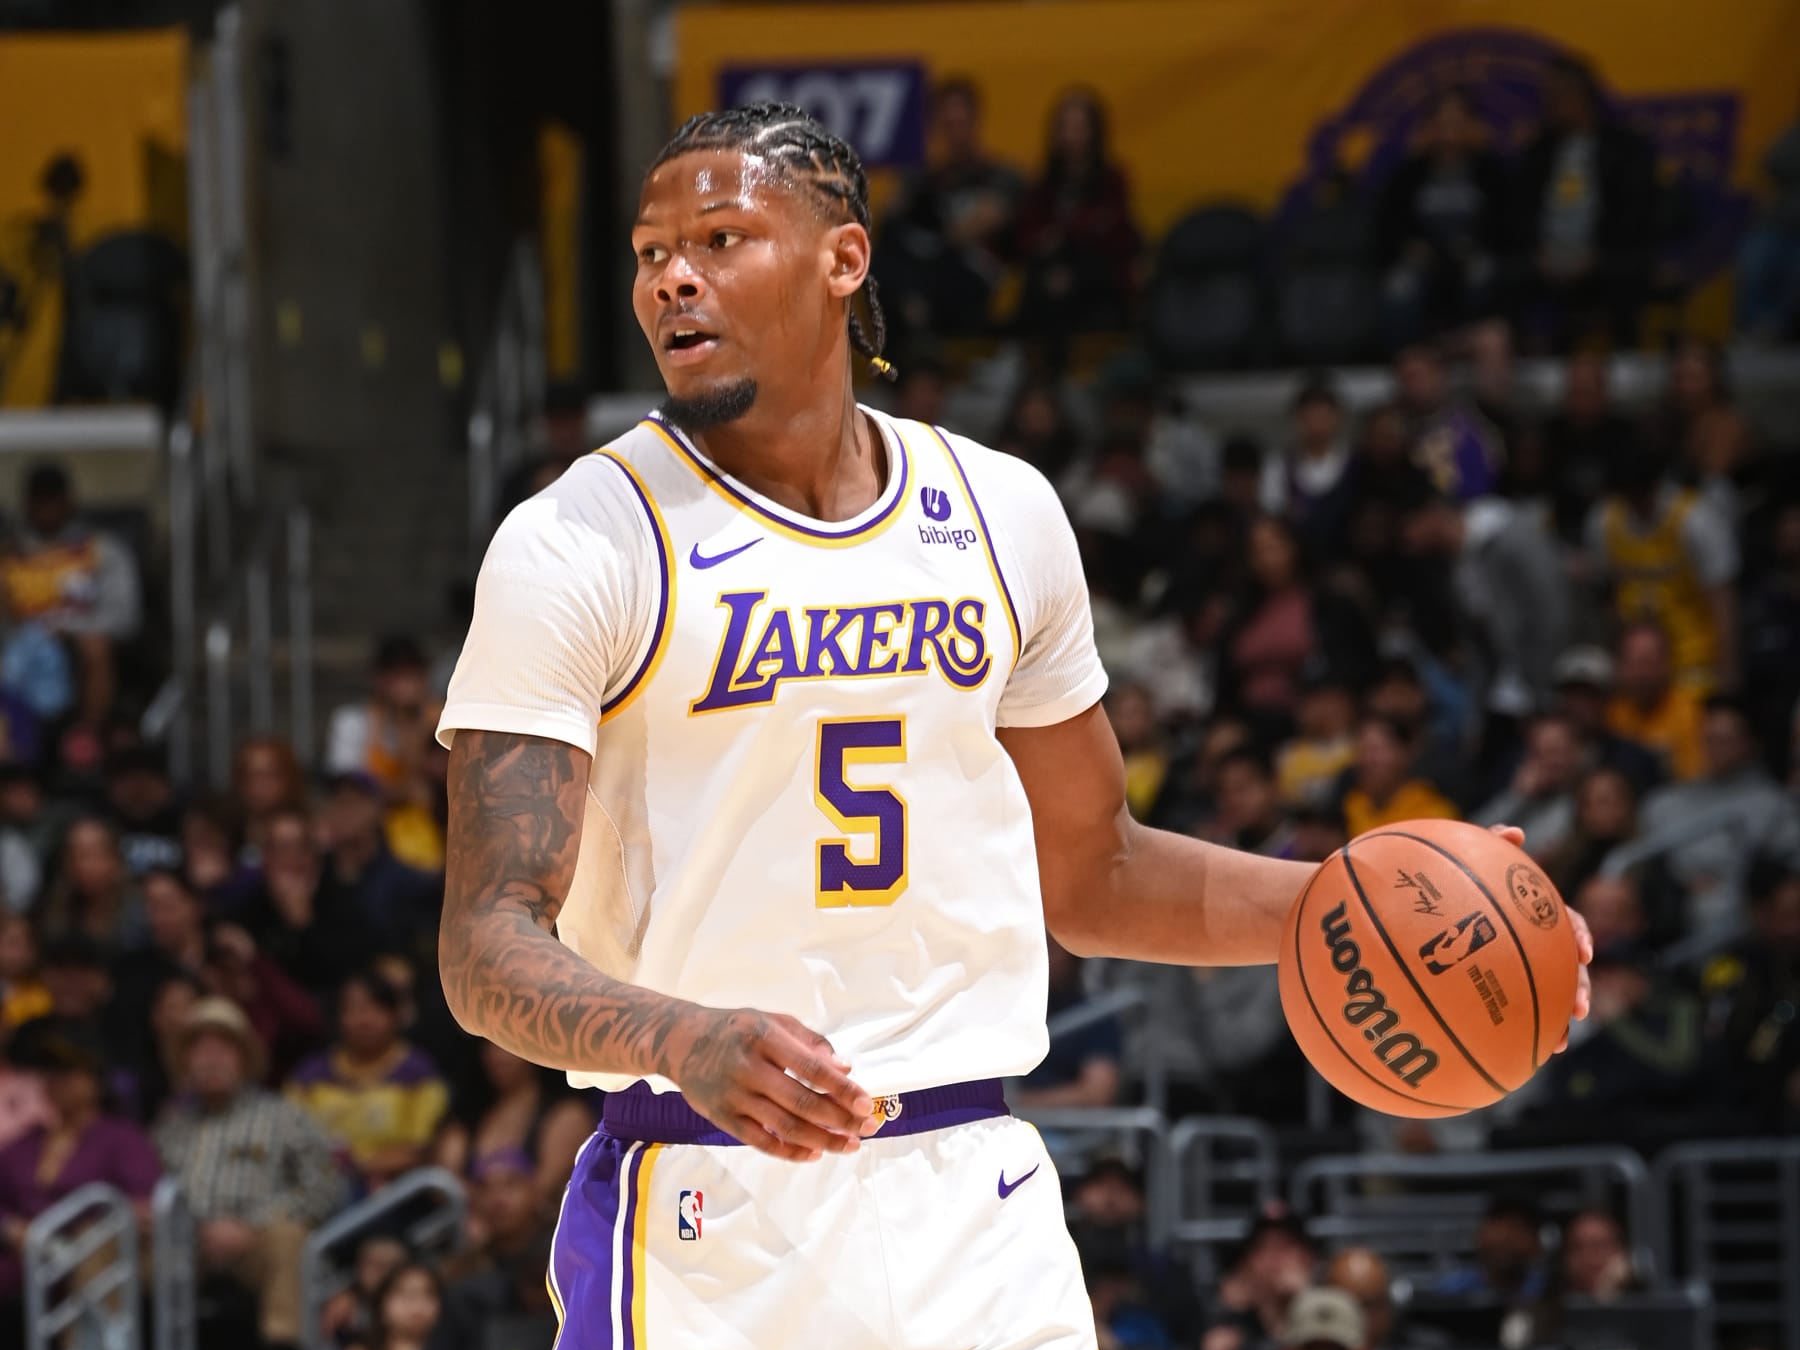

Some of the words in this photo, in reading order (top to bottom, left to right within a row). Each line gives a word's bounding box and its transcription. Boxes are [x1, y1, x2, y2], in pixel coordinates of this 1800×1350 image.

[918, 525, 977, 550] bibigo
[687, 588, 993, 718] LAKERS
[814, 713, 909, 909] 5
[1319, 898, 1440, 1089] Wilson
